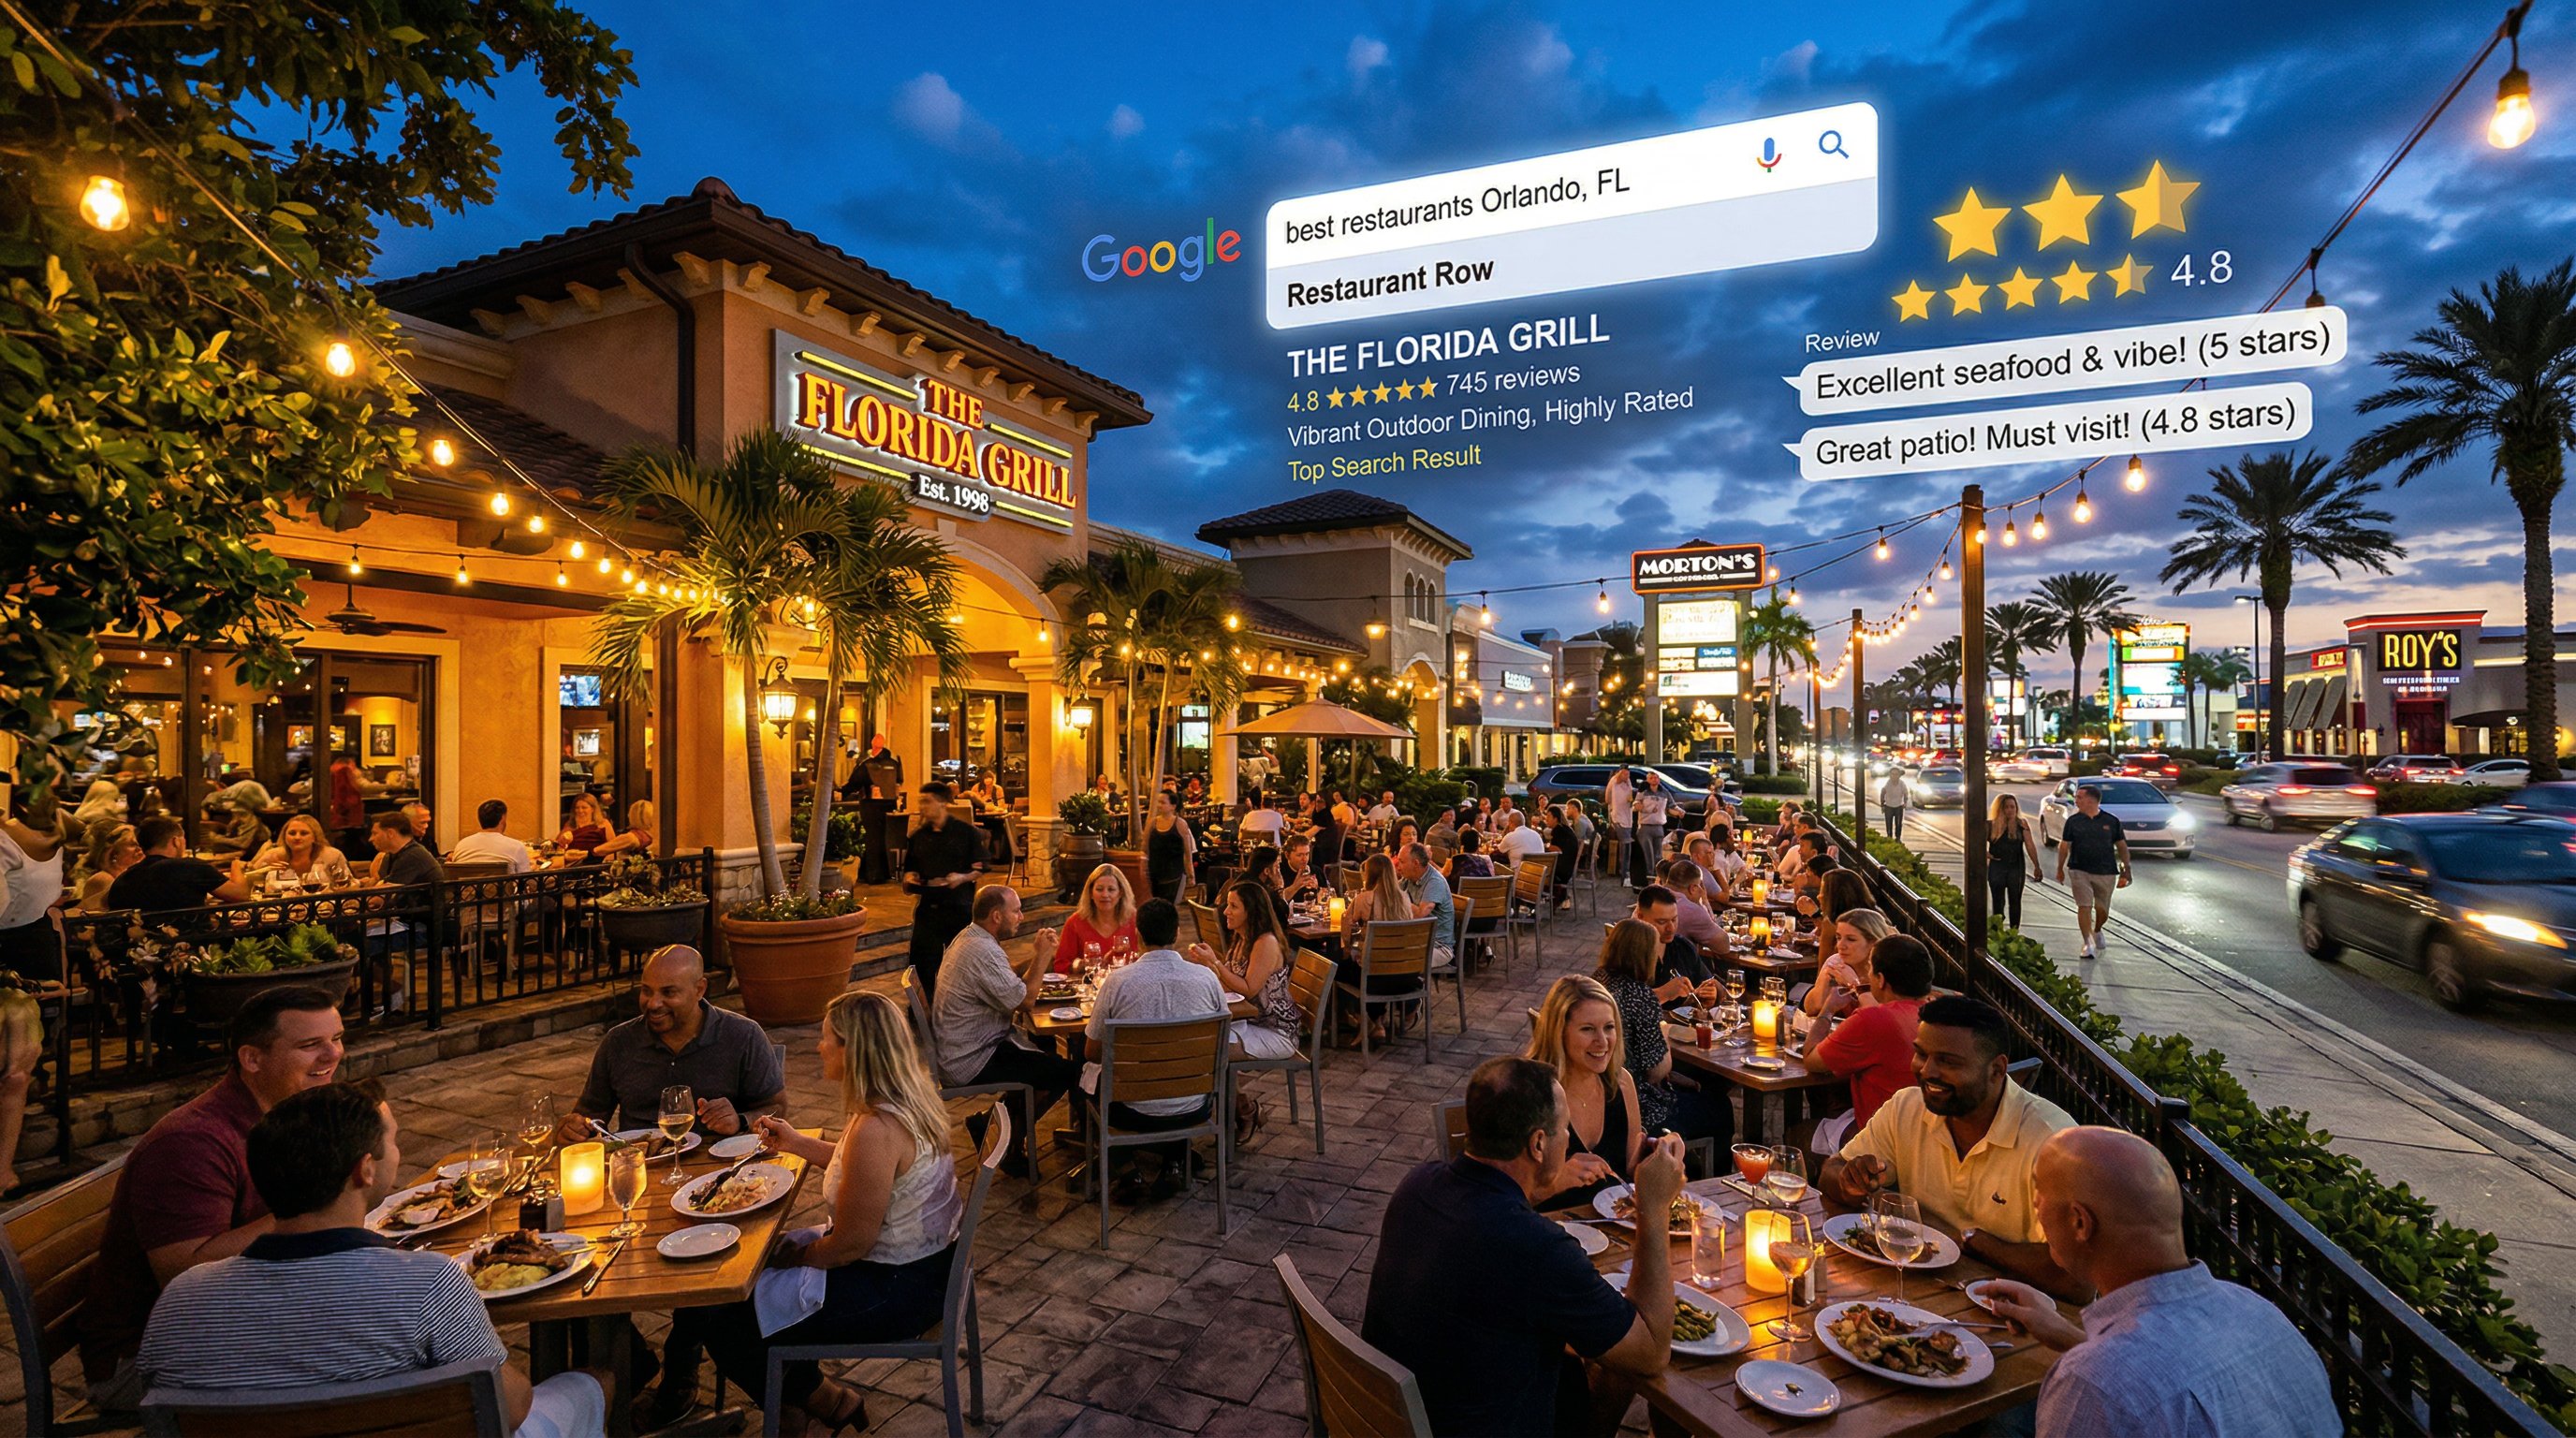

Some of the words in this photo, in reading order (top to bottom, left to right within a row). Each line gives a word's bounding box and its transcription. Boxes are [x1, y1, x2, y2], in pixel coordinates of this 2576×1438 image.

[921, 377, 984, 430] THE
[796, 372, 981, 480] FLORIDA
[984, 440, 1076, 509] GRILL
[918, 474, 950, 503] Est.
[953, 486, 989, 513] 1998
[1639, 552, 1757, 577] MORTON'S
[2384, 630, 2458, 668] ROY'S
